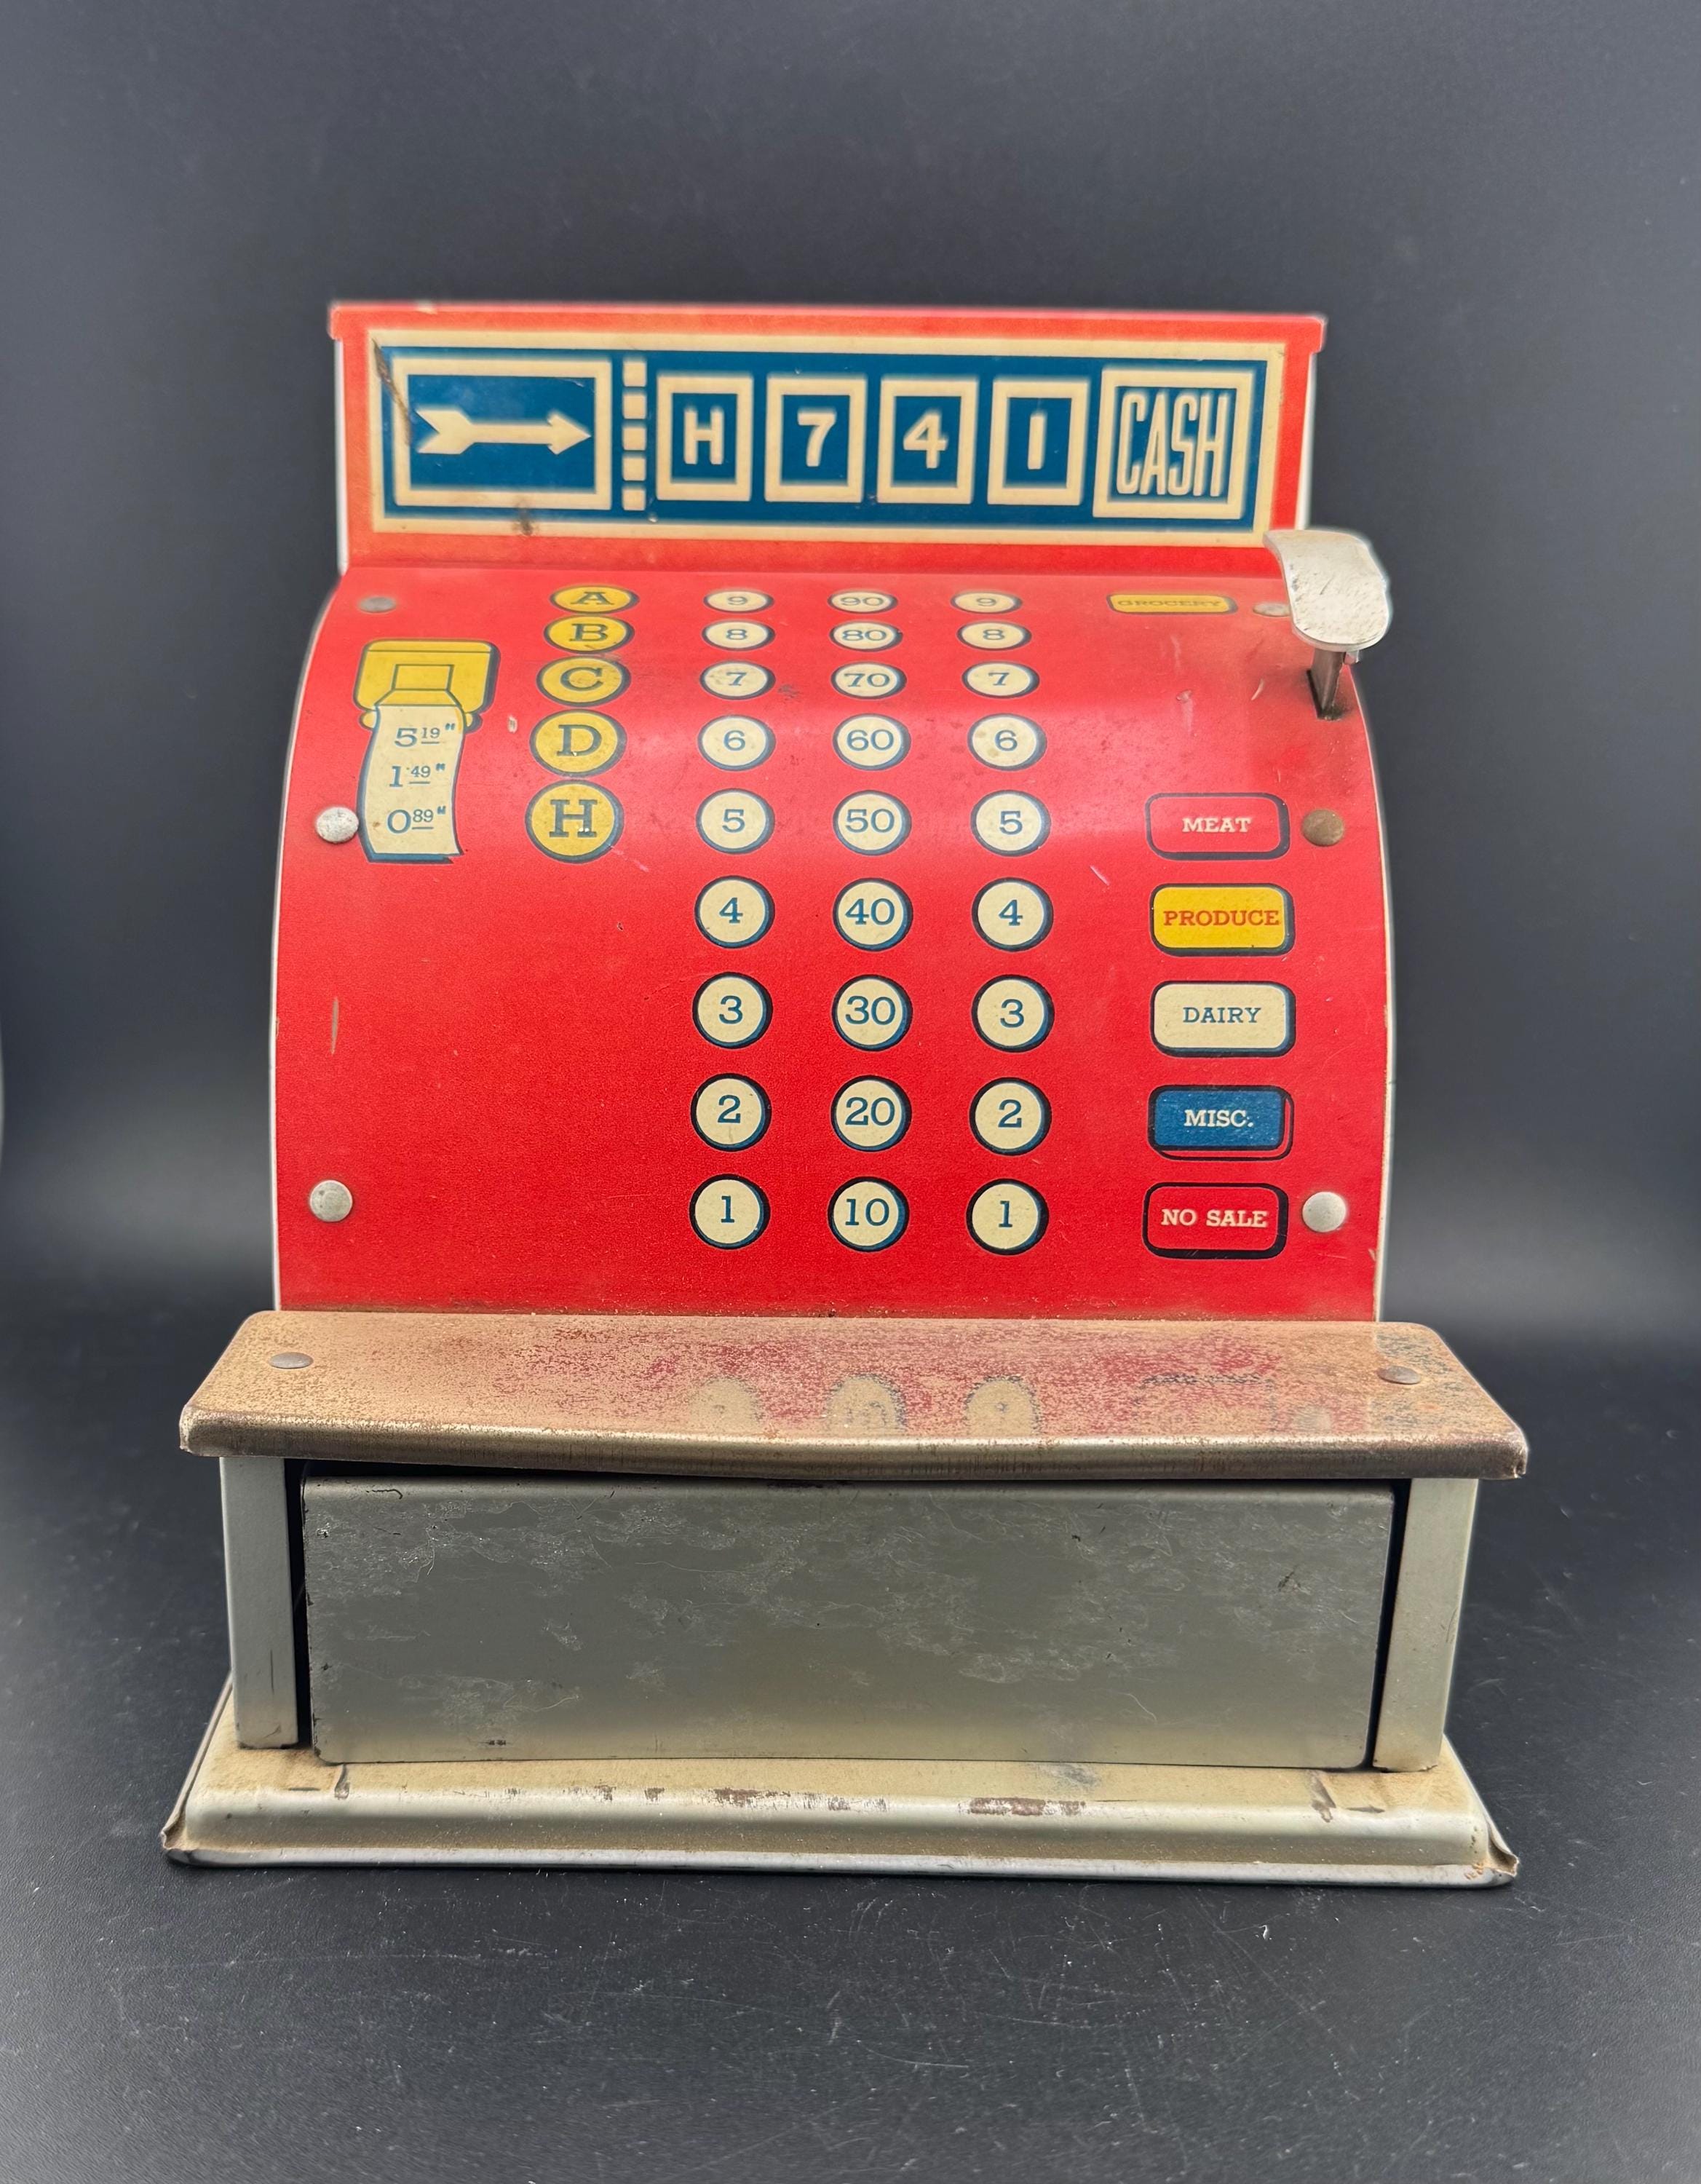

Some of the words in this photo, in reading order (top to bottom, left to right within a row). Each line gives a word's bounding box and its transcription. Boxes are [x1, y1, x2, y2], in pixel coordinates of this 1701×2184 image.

[684, 408, 723, 464] H
[798, 410, 836, 467] 7
[903, 411, 948, 468] 4
[1116, 391, 1228, 498] CASH
[571, 590, 614, 606] A
[726, 595, 748, 606] 9
[840, 596, 884, 607] 90
[976, 597, 998, 607] 9
[1117, 599, 1222, 607] GROCERY
[570, 623, 608, 641] B
[726, 629, 748, 640] 8
[842, 628, 887, 641] 80
[983, 629, 1005, 641] 8
[560, 667, 603, 691] C
[726, 672, 747, 686] 7
[844, 673, 891, 687] 70
[988, 673, 1010, 686] 7
[557, 724, 602, 756] D
[724, 730, 745, 751] 6
[846, 729, 894, 751] 60
[995, 730, 1018, 751] 6
[549, 799, 598, 838] H
[722, 809, 745, 833] 5
[845, 809, 895, 833] 50
[999, 811, 1023, 834] 5
[1183, 817, 1251, 833] MEAT
[719, 898, 743, 923] 4
[845, 898, 895, 925] 40
[999, 900, 1023, 925] 4
[1163, 910, 1280, 927] PRODUCE
[719, 996, 743, 1024] 3
[845, 996, 895, 1025] 30
[1000, 999, 1024, 1027] 3
[1183, 1007, 1262, 1024] DAIRY
[718, 1095, 740, 1123] 2
[845, 1097, 895, 1125] 20
[998, 1099, 1021, 1128] 2
[1183, 1109, 1254, 1128] MISC.
[721, 1195, 735, 1223] 1
[846, 1198, 889, 1226] 10
[999, 1200, 1013, 1227] 1
[1161, 1208, 1197, 1227] NO
[1206, 1210, 1267, 1228] SALE
